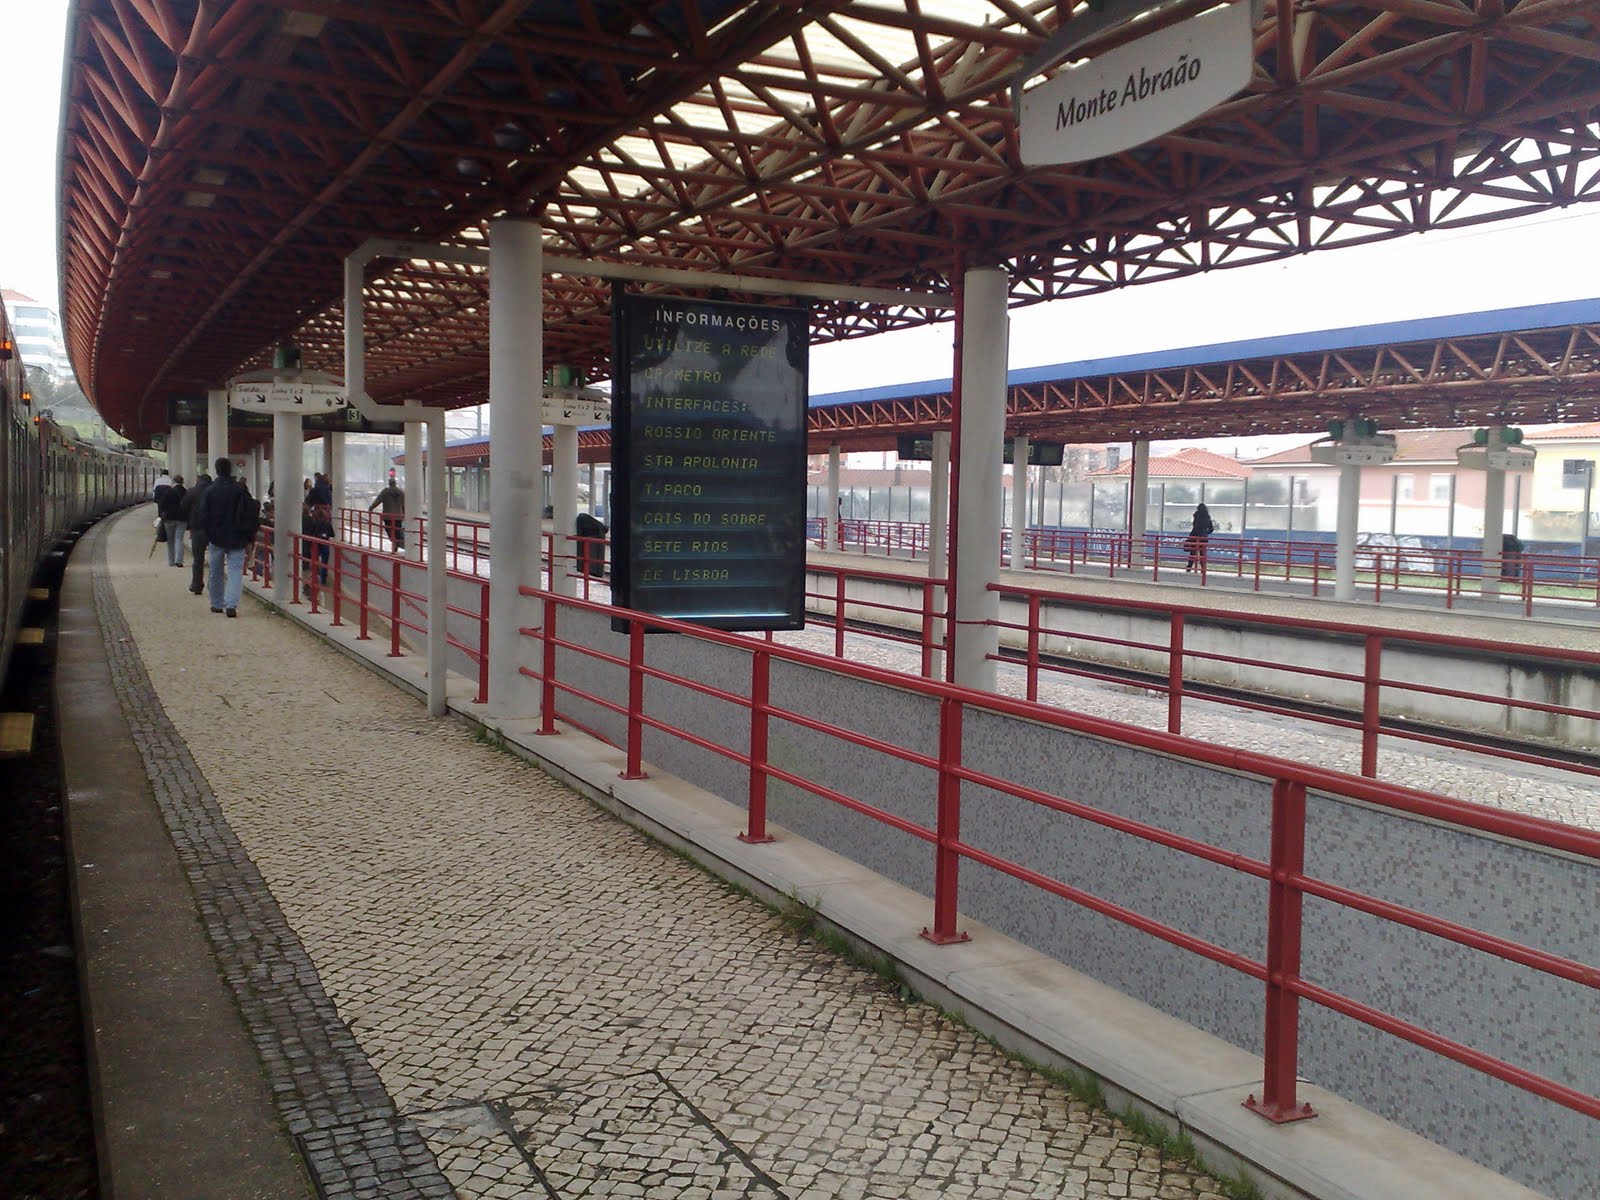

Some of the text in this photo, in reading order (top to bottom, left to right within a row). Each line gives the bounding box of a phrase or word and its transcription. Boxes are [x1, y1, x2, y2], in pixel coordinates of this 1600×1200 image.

[1056, 54, 1201, 130] Monte Abraão
[656, 309, 780, 331] INFORMAÇÕES
[644, 337, 712, 354] UTILIZE
[722, 344, 731, 355] A
[646, 396, 747, 413] INTERFACES:
[350, 410, 358, 420] 3
[644, 425, 777, 442] ROSSIO ORIENTE
[644, 455, 758, 469] STA APOLONIA
[644, 512, 682, 524] CAIS
[693, 513, 711, 524] DO
[644, 541, 729, 552] SETE RIOS
[673, 569, 729, 581] LISBOA
